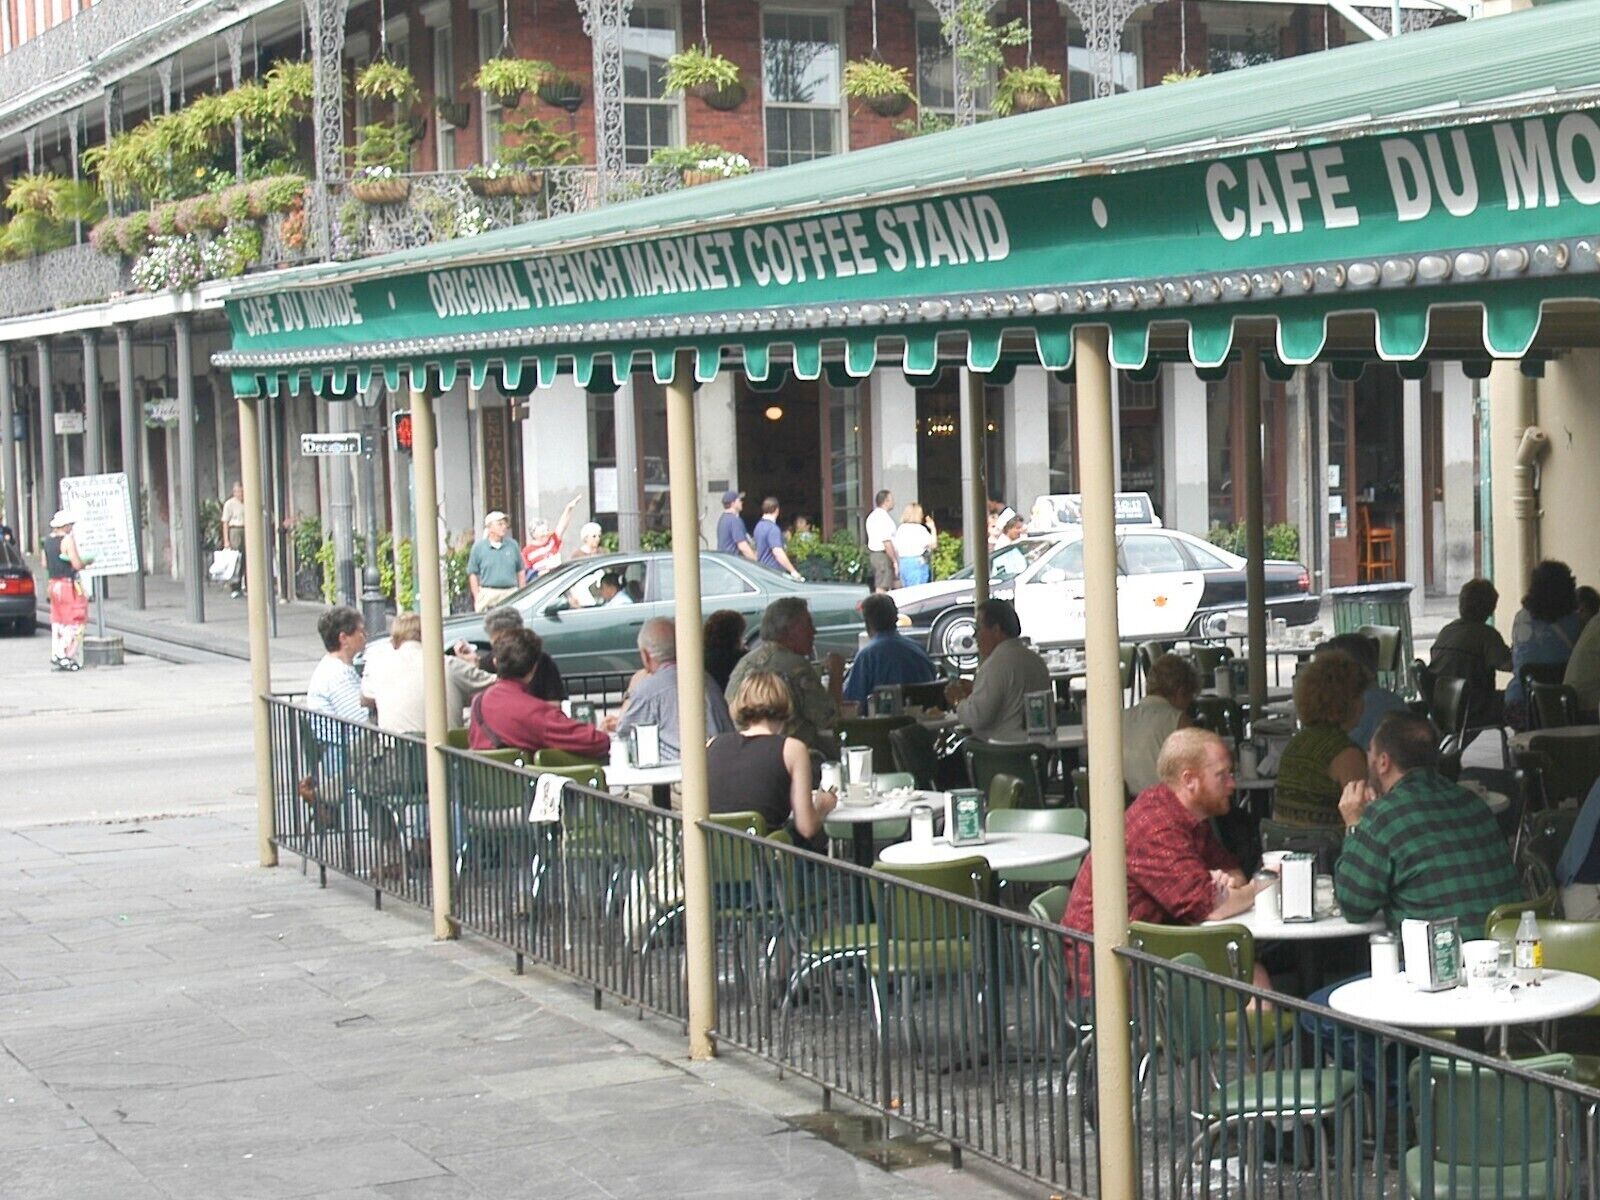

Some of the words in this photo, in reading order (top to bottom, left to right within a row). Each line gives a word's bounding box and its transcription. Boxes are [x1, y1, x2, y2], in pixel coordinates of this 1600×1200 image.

[239, 296, 280, 338] CAFE
[276, 290, 304, 332] DU
[301, 283, 363, 329] MONDE
[427, 262, 531, 319] ORIGINAL
[523, 248, 627, 309] FRENCH
[618, 230, 742, 298] MARKET
[743, 213, 878, 288] COFFEE
[875, 194, 1010, 272] STAND
[1205, 146, 1360, 241] CAFE
[1380, 129, 1479, 222] DU
